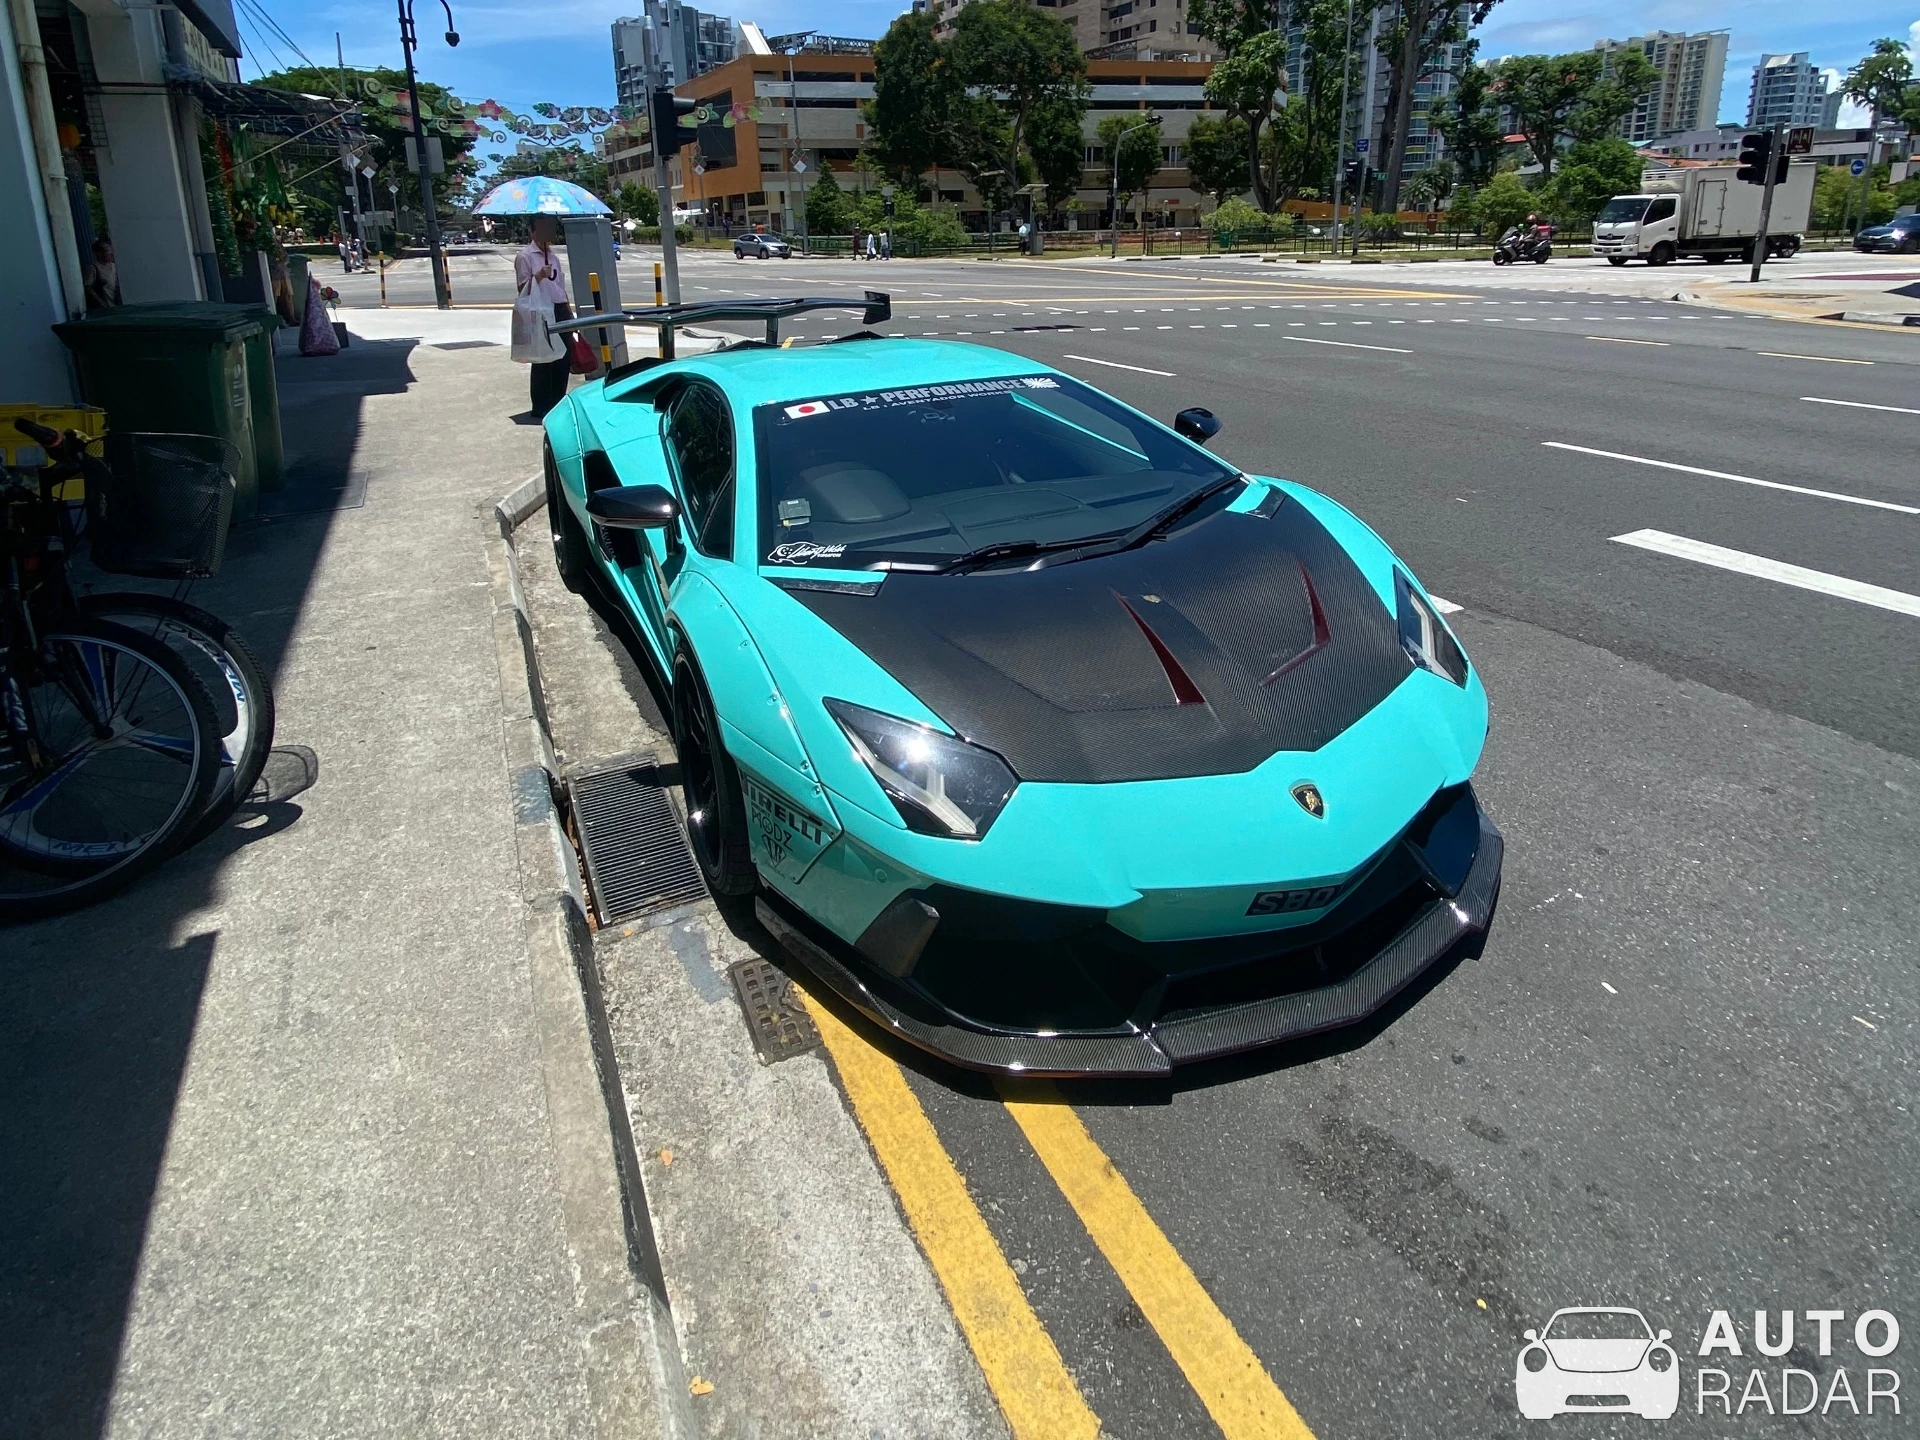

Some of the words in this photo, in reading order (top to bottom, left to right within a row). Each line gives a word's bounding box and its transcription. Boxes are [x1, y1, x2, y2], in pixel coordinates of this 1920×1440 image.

[828, 397, 859, 411] LB
[880, 379, 1026, 402] PERFORMANCE
[891, 395, 965, 407] AVENTADOR
[969, 390, 1010, 398] WORKS
